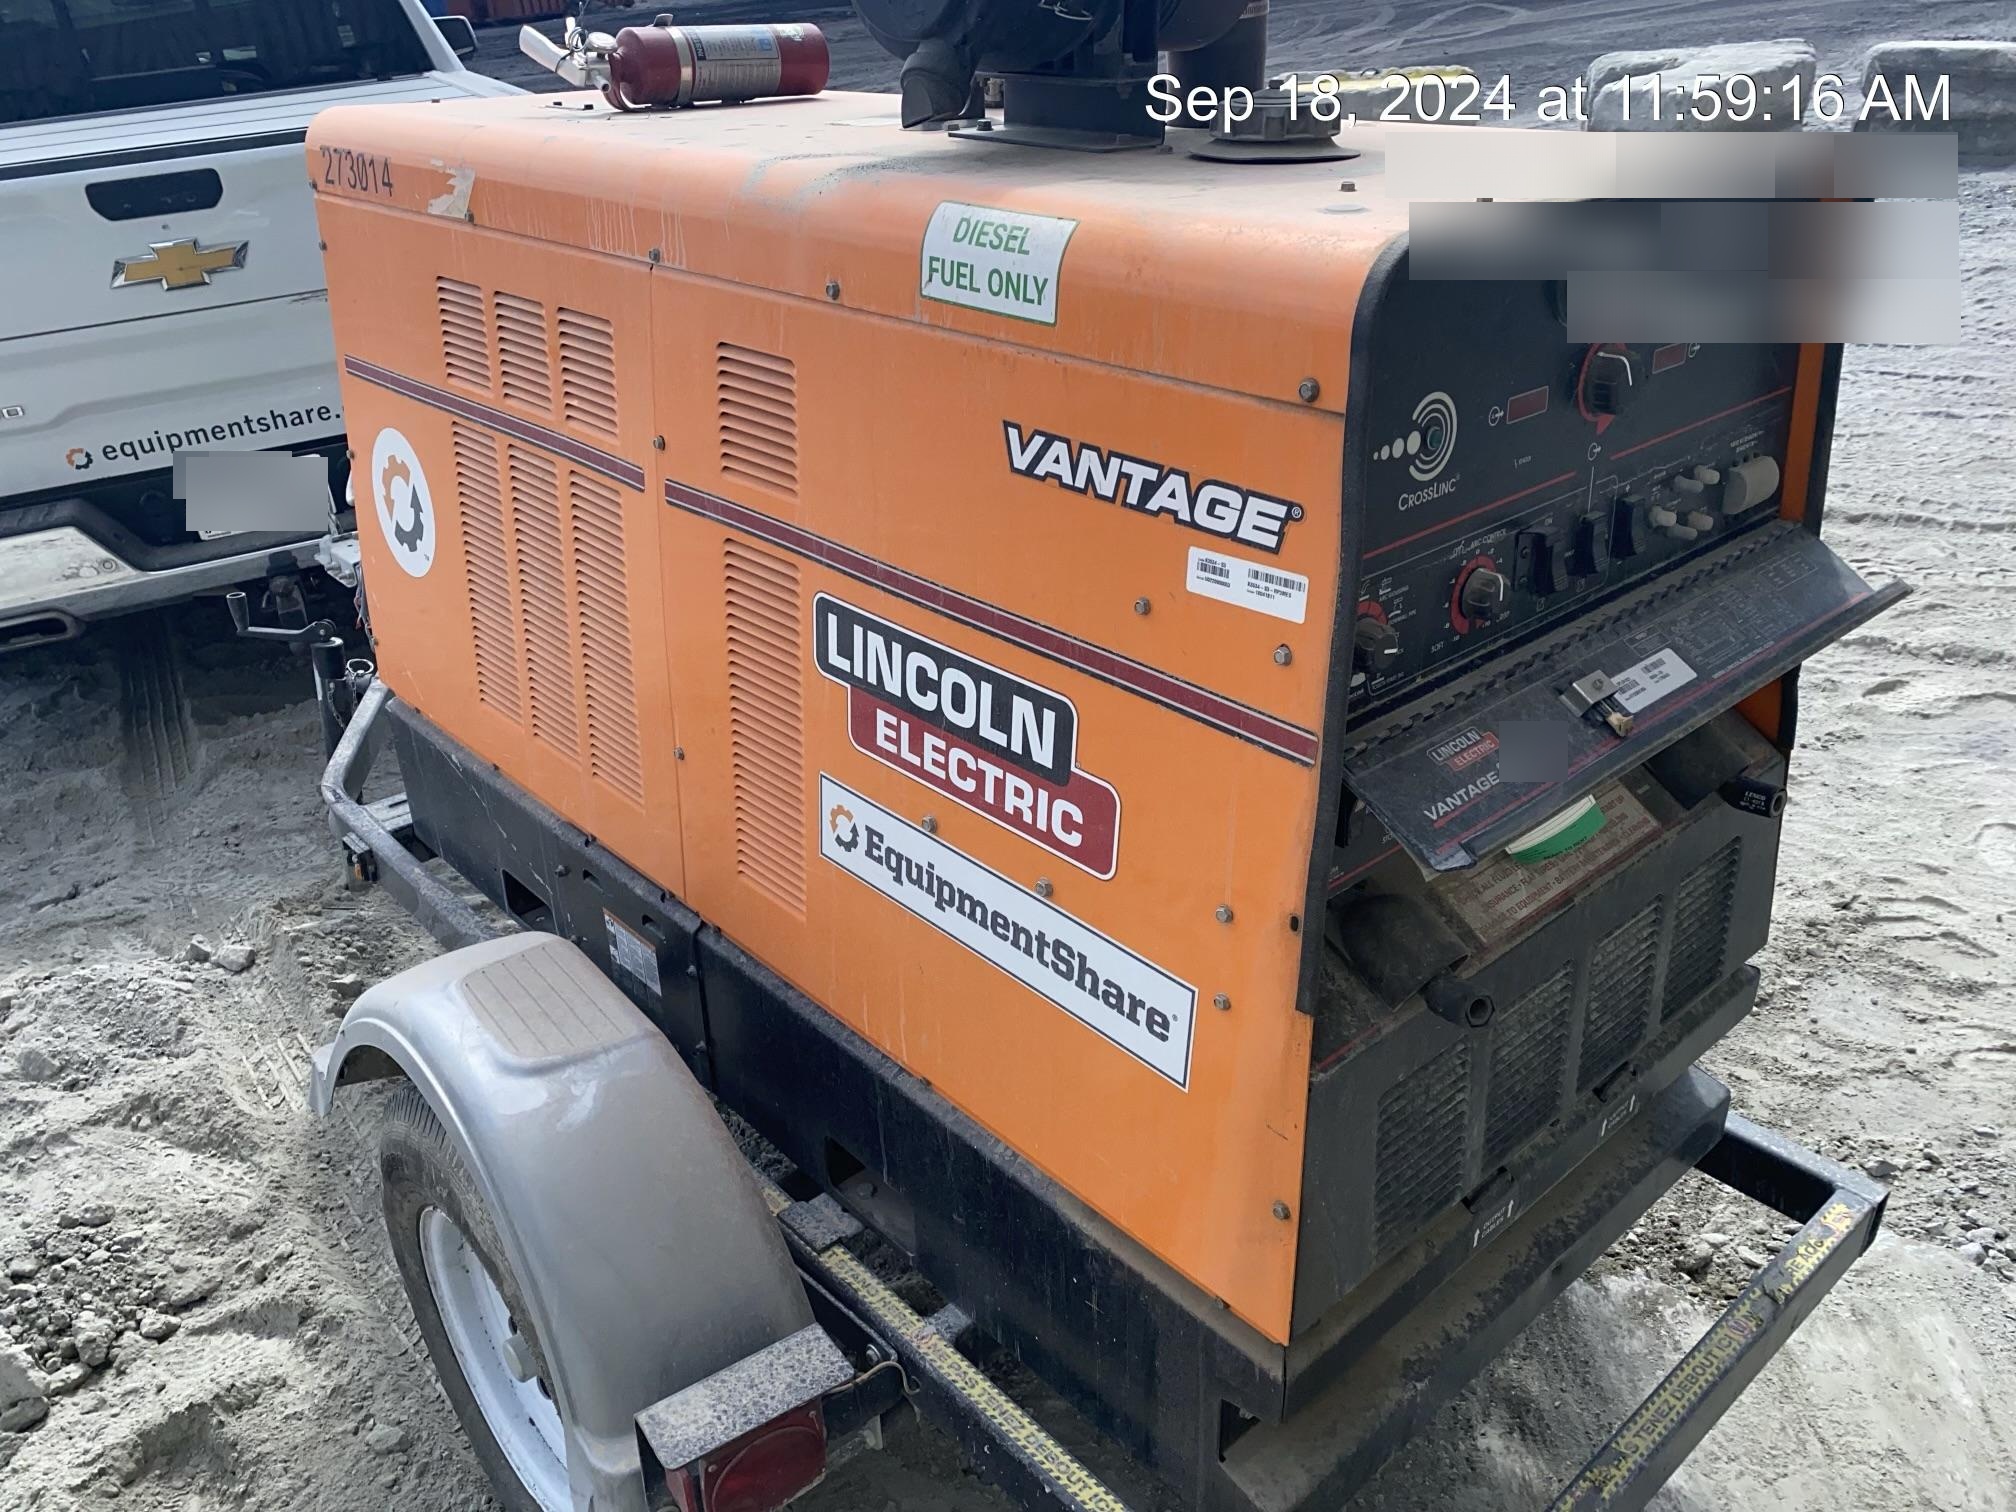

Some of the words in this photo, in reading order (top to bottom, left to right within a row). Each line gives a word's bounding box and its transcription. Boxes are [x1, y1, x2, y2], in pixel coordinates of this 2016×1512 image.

[320, 145, 393, 197] 273014
[952, 217, 1031, 256] DIESEL
[928, 255, 981, 294] FUEL
[987, 267, 1049, 306] ONLY
[102, 403, 345, 461] equipmentshare.
[1007, 426, 1288, 549] VANTAGE
[827, 612, 1056, 770] LINCOLN
[1431, 730, 1482, 762] LINCOLN
[1454, 739, 1496, 766] ELECTRIC
[876, 707, 1084, 848] ELECTRIC
[865, 824, 1171, 1043] EquipmentShare
[1633, 1401, 1676, 1442] TENEZ
[1672, 1351, 1720, 1401] DEBOUT
